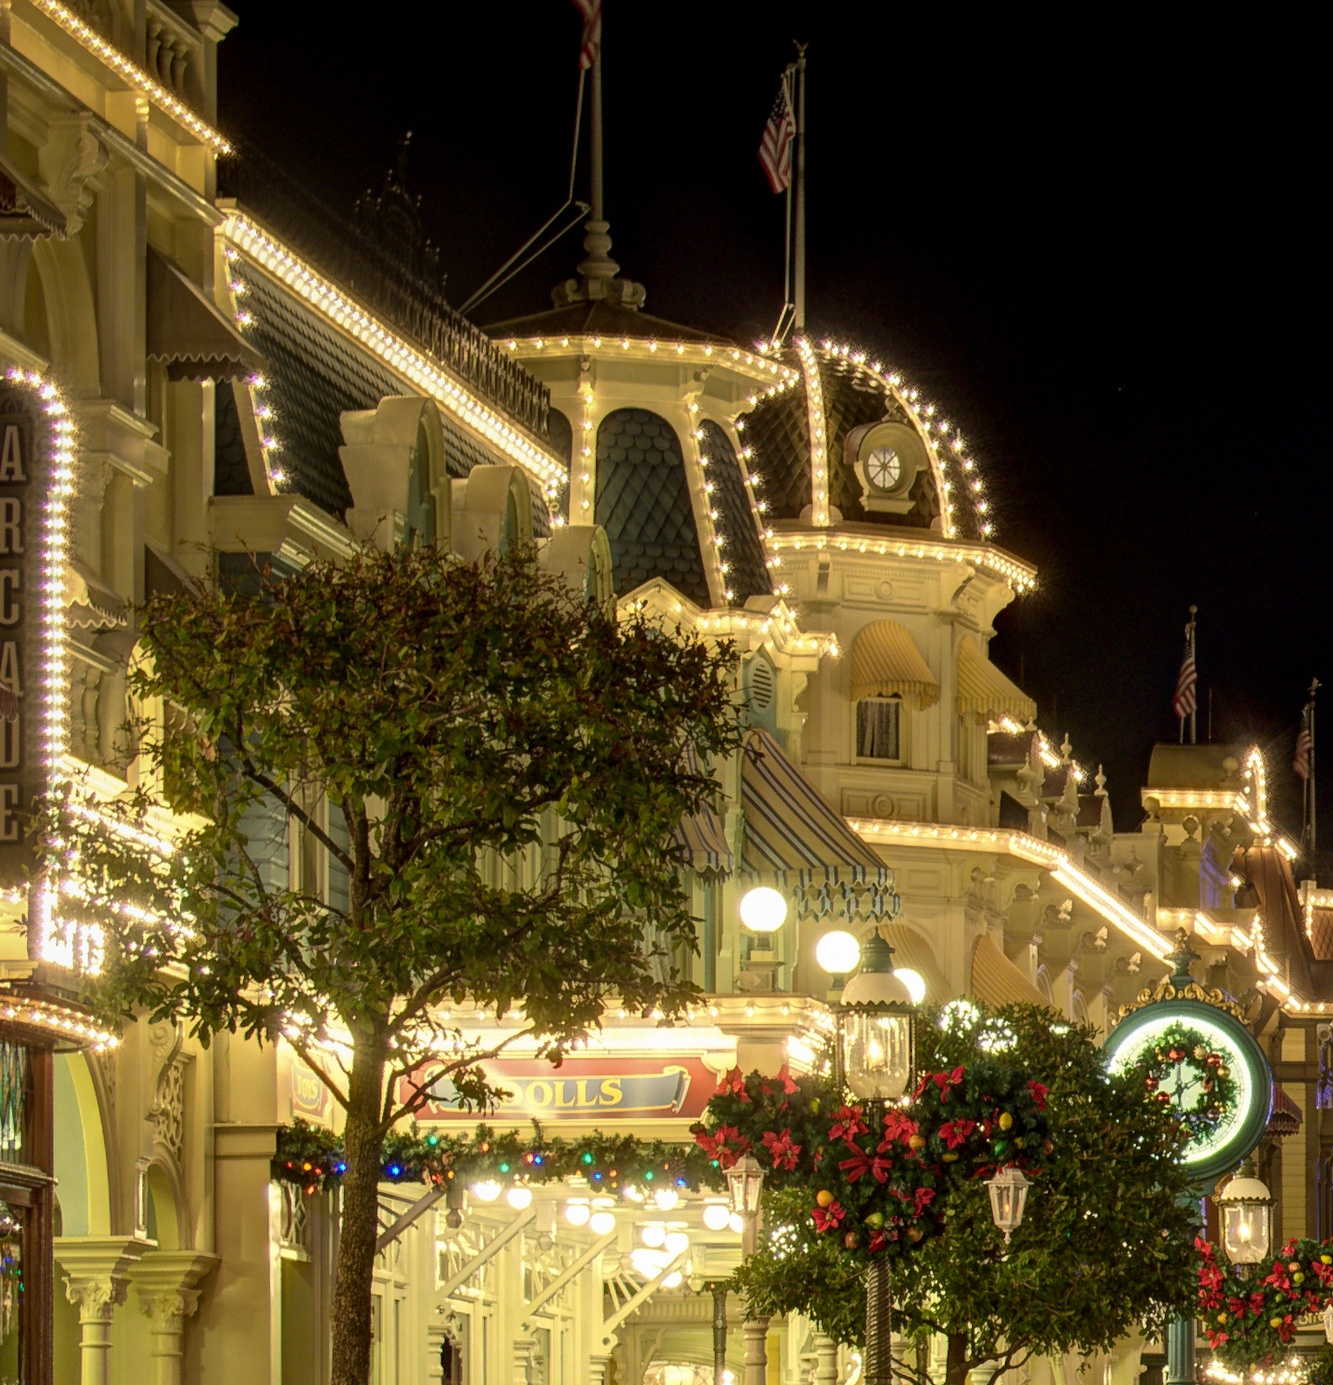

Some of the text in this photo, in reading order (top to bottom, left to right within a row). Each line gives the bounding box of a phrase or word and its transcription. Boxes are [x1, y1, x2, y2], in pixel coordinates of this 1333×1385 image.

[0, 425, 26, 841] ARCADE
[297, 1074, 318, 1100] TOYS
[499, 1077, 623, 1108] DOLLS
